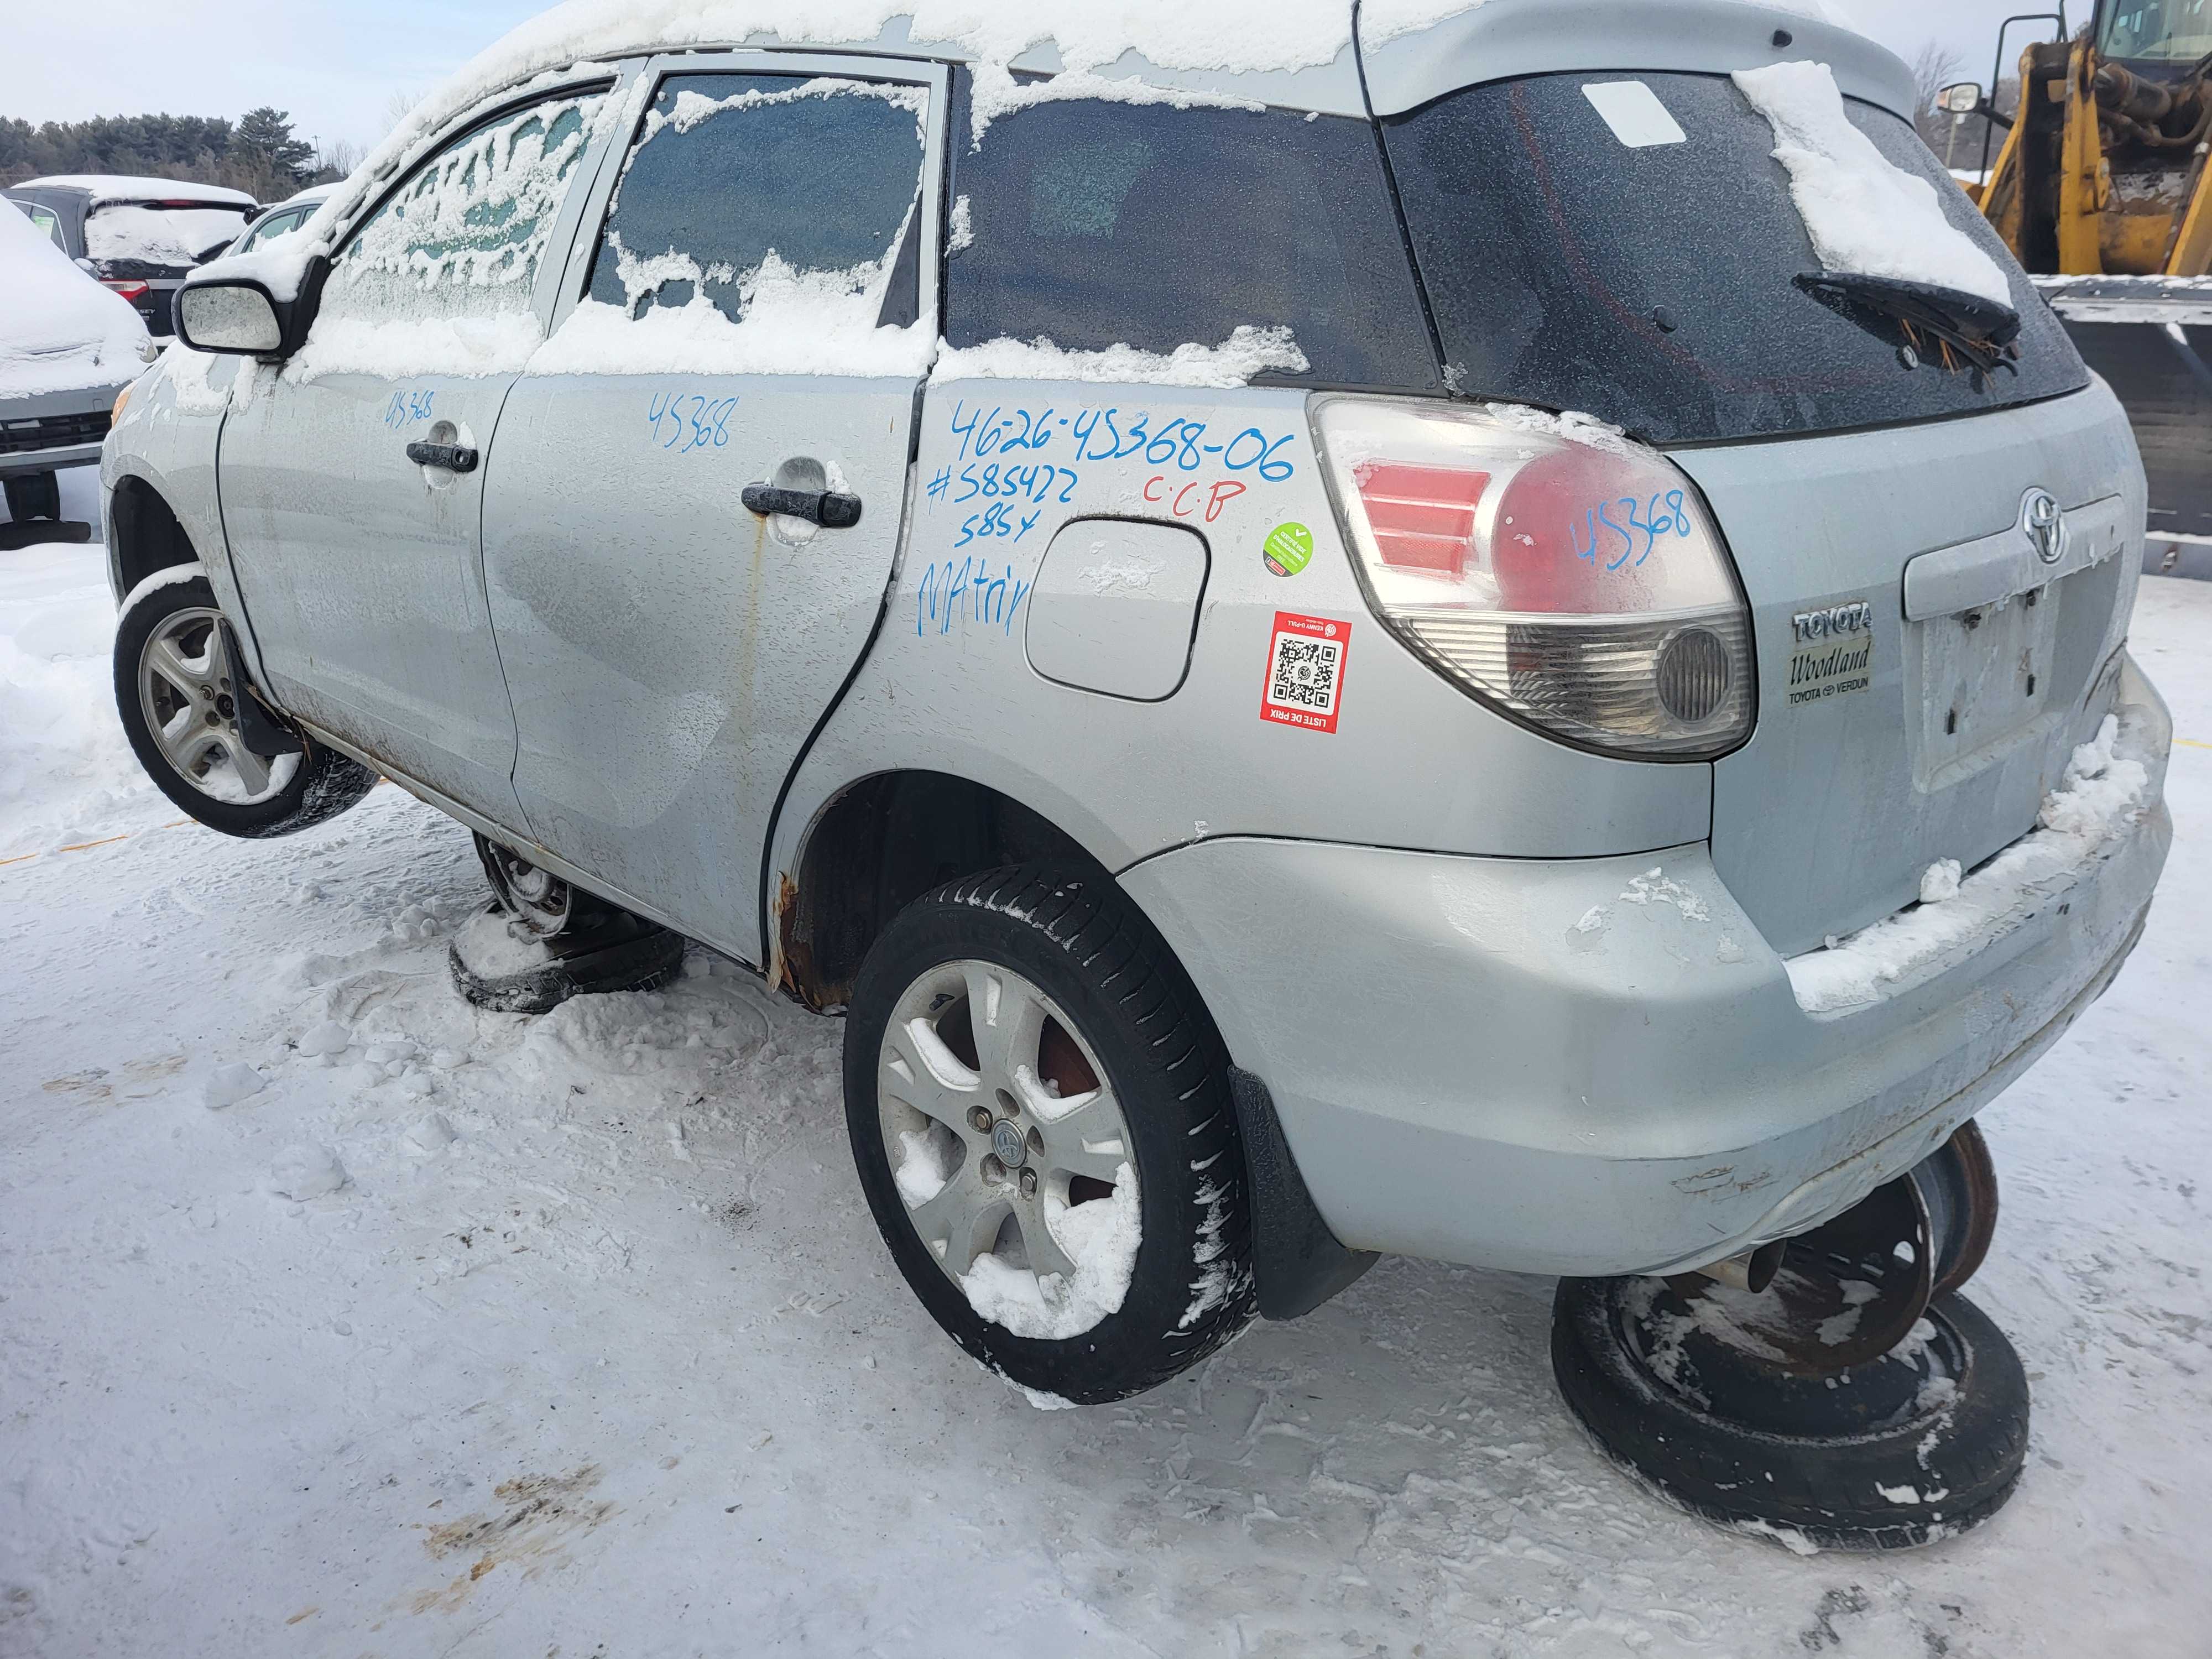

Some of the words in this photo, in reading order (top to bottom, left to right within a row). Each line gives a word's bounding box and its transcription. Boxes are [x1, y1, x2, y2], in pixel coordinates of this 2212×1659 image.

[386, 390, 435, 429] 45368
[649, 392, 740, 453] 45368
[1571, 489, 1691, 570] 45368
[1287, 620, 1306, 629] U-PULL
[1306, 623, 1324, 632] KENNY
[1792, 602, 1873, 641] TOYOTA
[1788, 640, 1871, 686] Woodland
[1789, 688, 1820, 704] TOYOTA
[1837, 676, 1869, 693] VERDUN
[1270, 708, 1290, 721] PRIX
[1291, 713, 1303, 723] DE
[1303, 715, 1327, 728] LISTE
